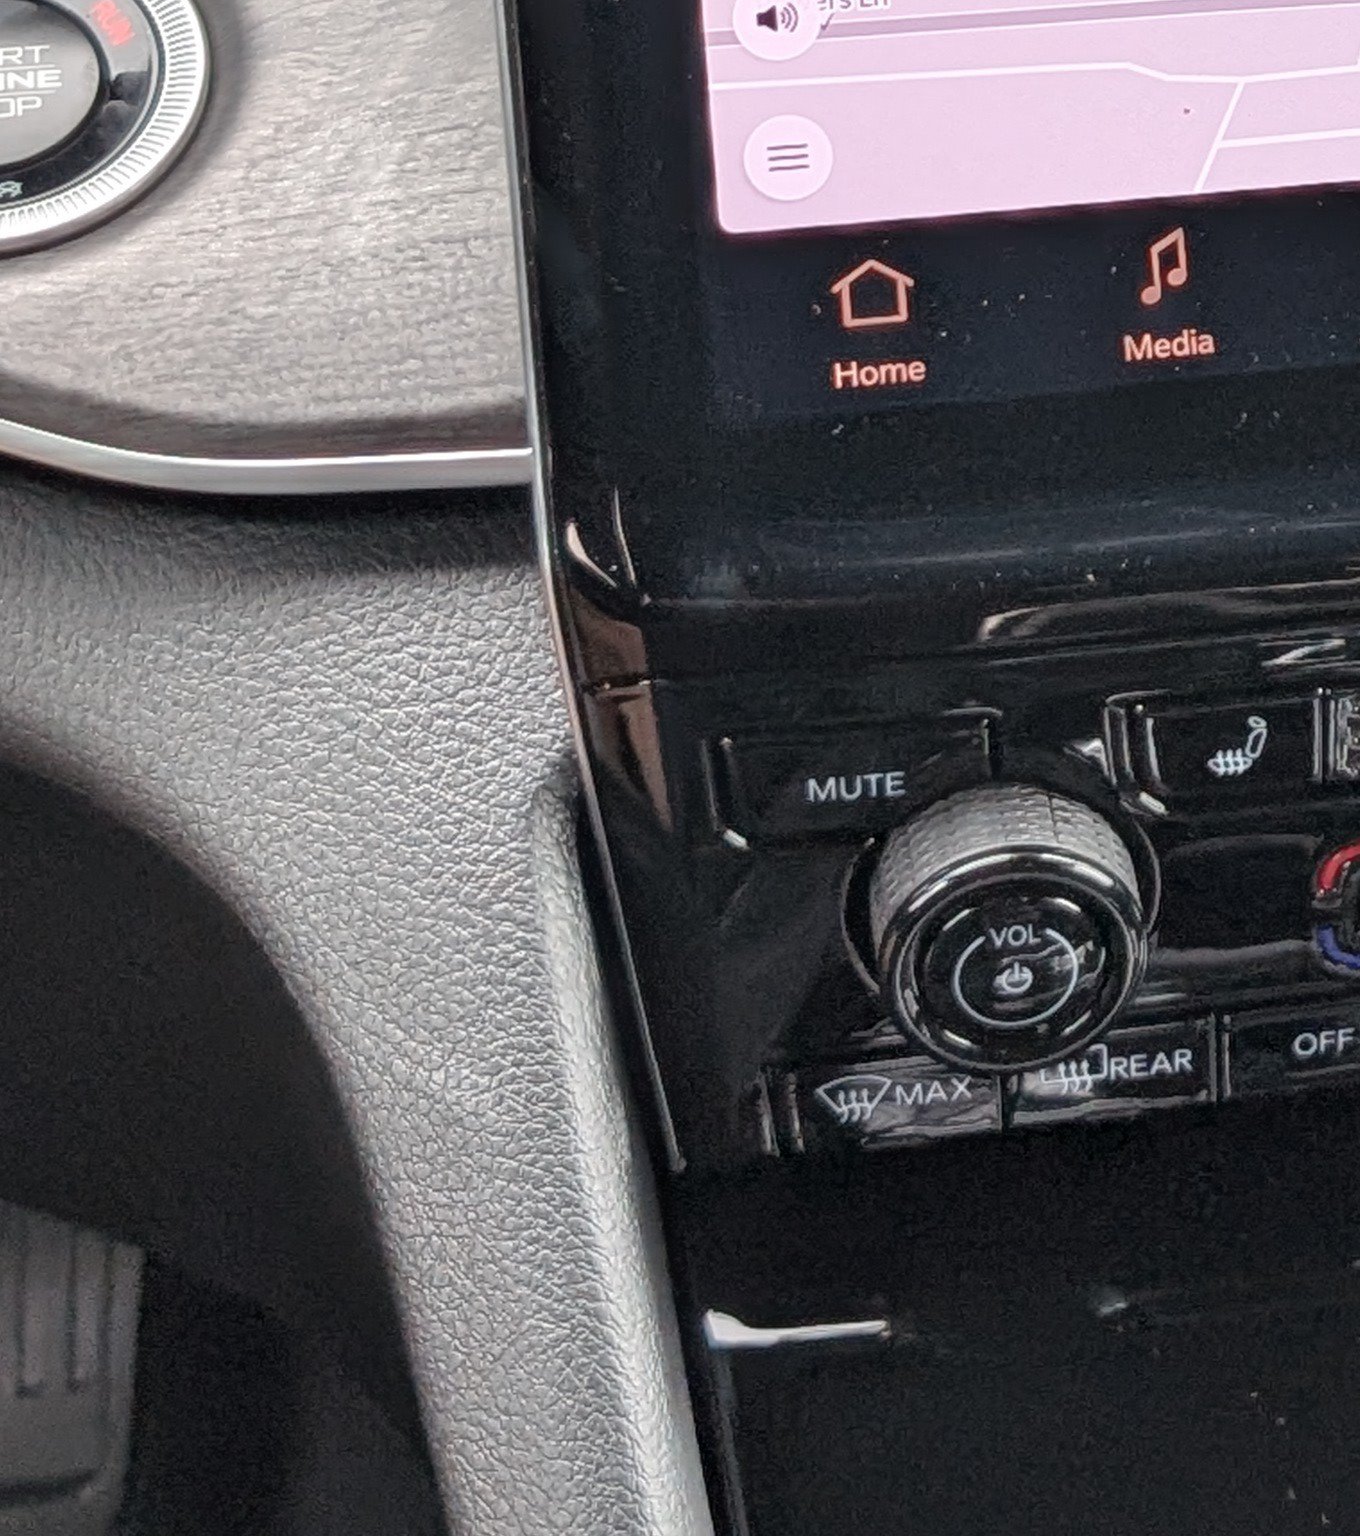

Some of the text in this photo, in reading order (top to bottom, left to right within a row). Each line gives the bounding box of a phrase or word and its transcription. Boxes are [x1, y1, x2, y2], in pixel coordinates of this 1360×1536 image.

[1123, 330, 1215, 362] Media
[832, 359, 927, 390] Home
[805, 770, 906, 803] MUTE
[990, 925, 1042, 948] VOL
[1292, 1027, 1356, 1060] OFF
[1110, 1047, 1194, 1082] REAR
[897, 1076, 972, 1106] MAX
